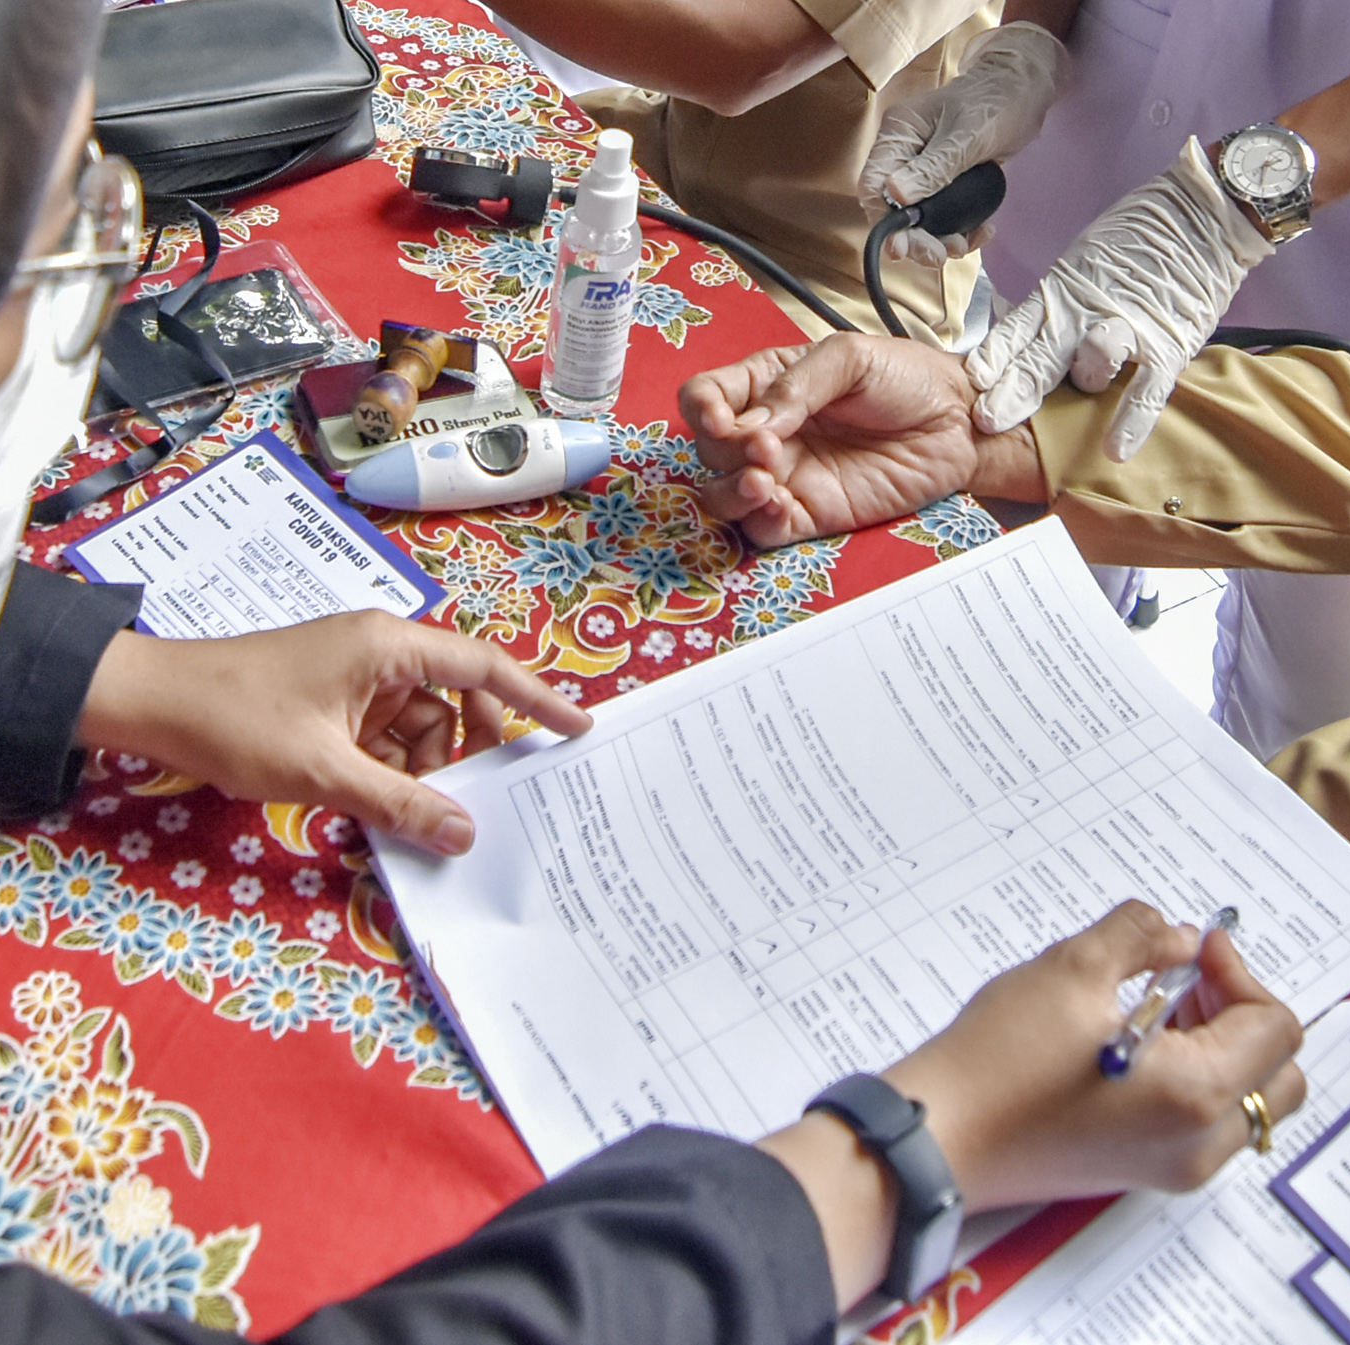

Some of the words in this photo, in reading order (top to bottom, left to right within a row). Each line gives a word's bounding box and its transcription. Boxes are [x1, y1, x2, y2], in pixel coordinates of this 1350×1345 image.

[580, 301, 616, 310] HAND
[443, 411, 490, 431] Stamp
[492, 406, 523, 421] Pad
[205, 483, 215, 493] No.
[215, 493, 226, 504] NIK
[218, 475, 227, 485] No
[226, 483, 250, 507] Register
[179, 499, 199, 520] Alamat
[192, 491, 209, 509] Nama
[207, 506, 232, 531] Lengkap
[125, 530, 135, 541] No.
[134, 540, 144, 551] Hp
[138, 523, 154, 539] Jenis
[153, 538, 176, 561] Kelamin
[152, 515, 175, 538] Tanggal
[173, 535, 188, 552] Lahir
[285, 492, 319, 530] KARTU
[316, 518, 372, 571] VAKSINASI
[289, 519, 323, 550] COVID
[320, 549, 336, 565] 19
[111, 538, 130, 558] Lokasi
[128, 556, 155, 584] Penerima
[543, 866, 563, 902] Lanjut
[558, 902, 579, 934] Tindak
[637, 1020, 655, 1043] Hasil
